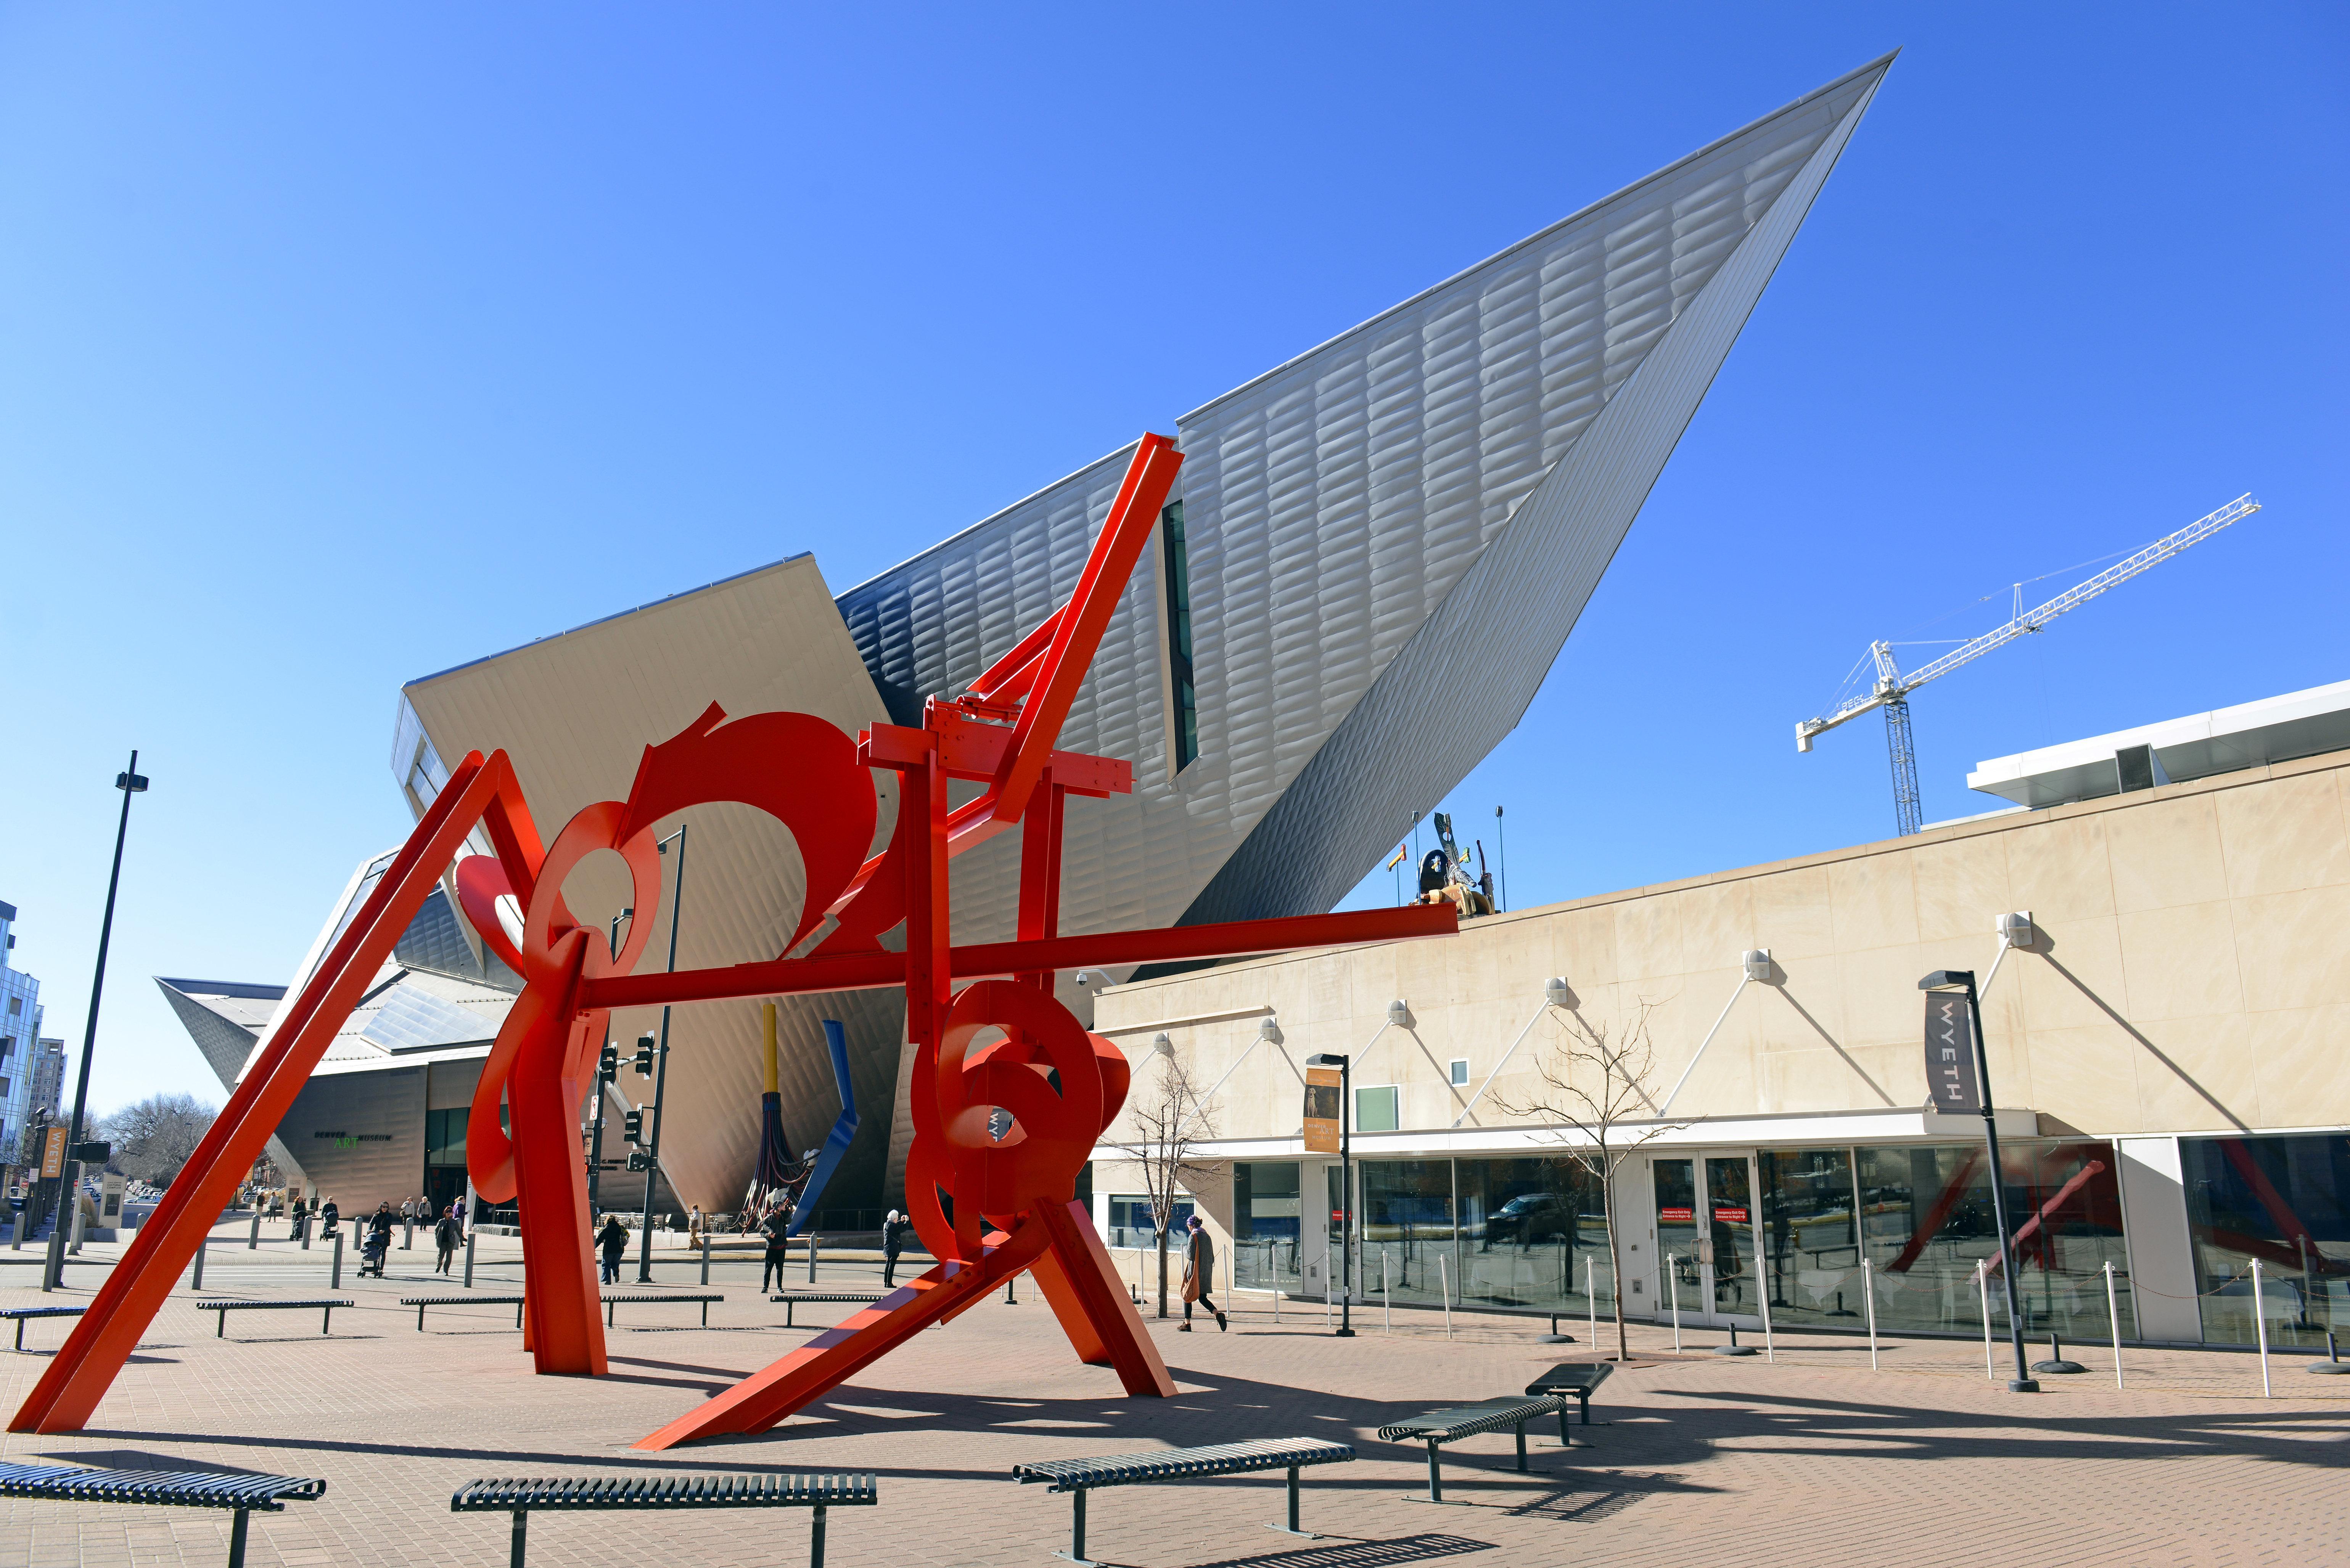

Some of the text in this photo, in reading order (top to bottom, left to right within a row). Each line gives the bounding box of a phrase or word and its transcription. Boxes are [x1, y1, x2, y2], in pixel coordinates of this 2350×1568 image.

[1941, 1002, 1963, 1100] WYETH
[46, 1132, 62, 1173] WYETH
[333, 1137, 359, 1149] ART
